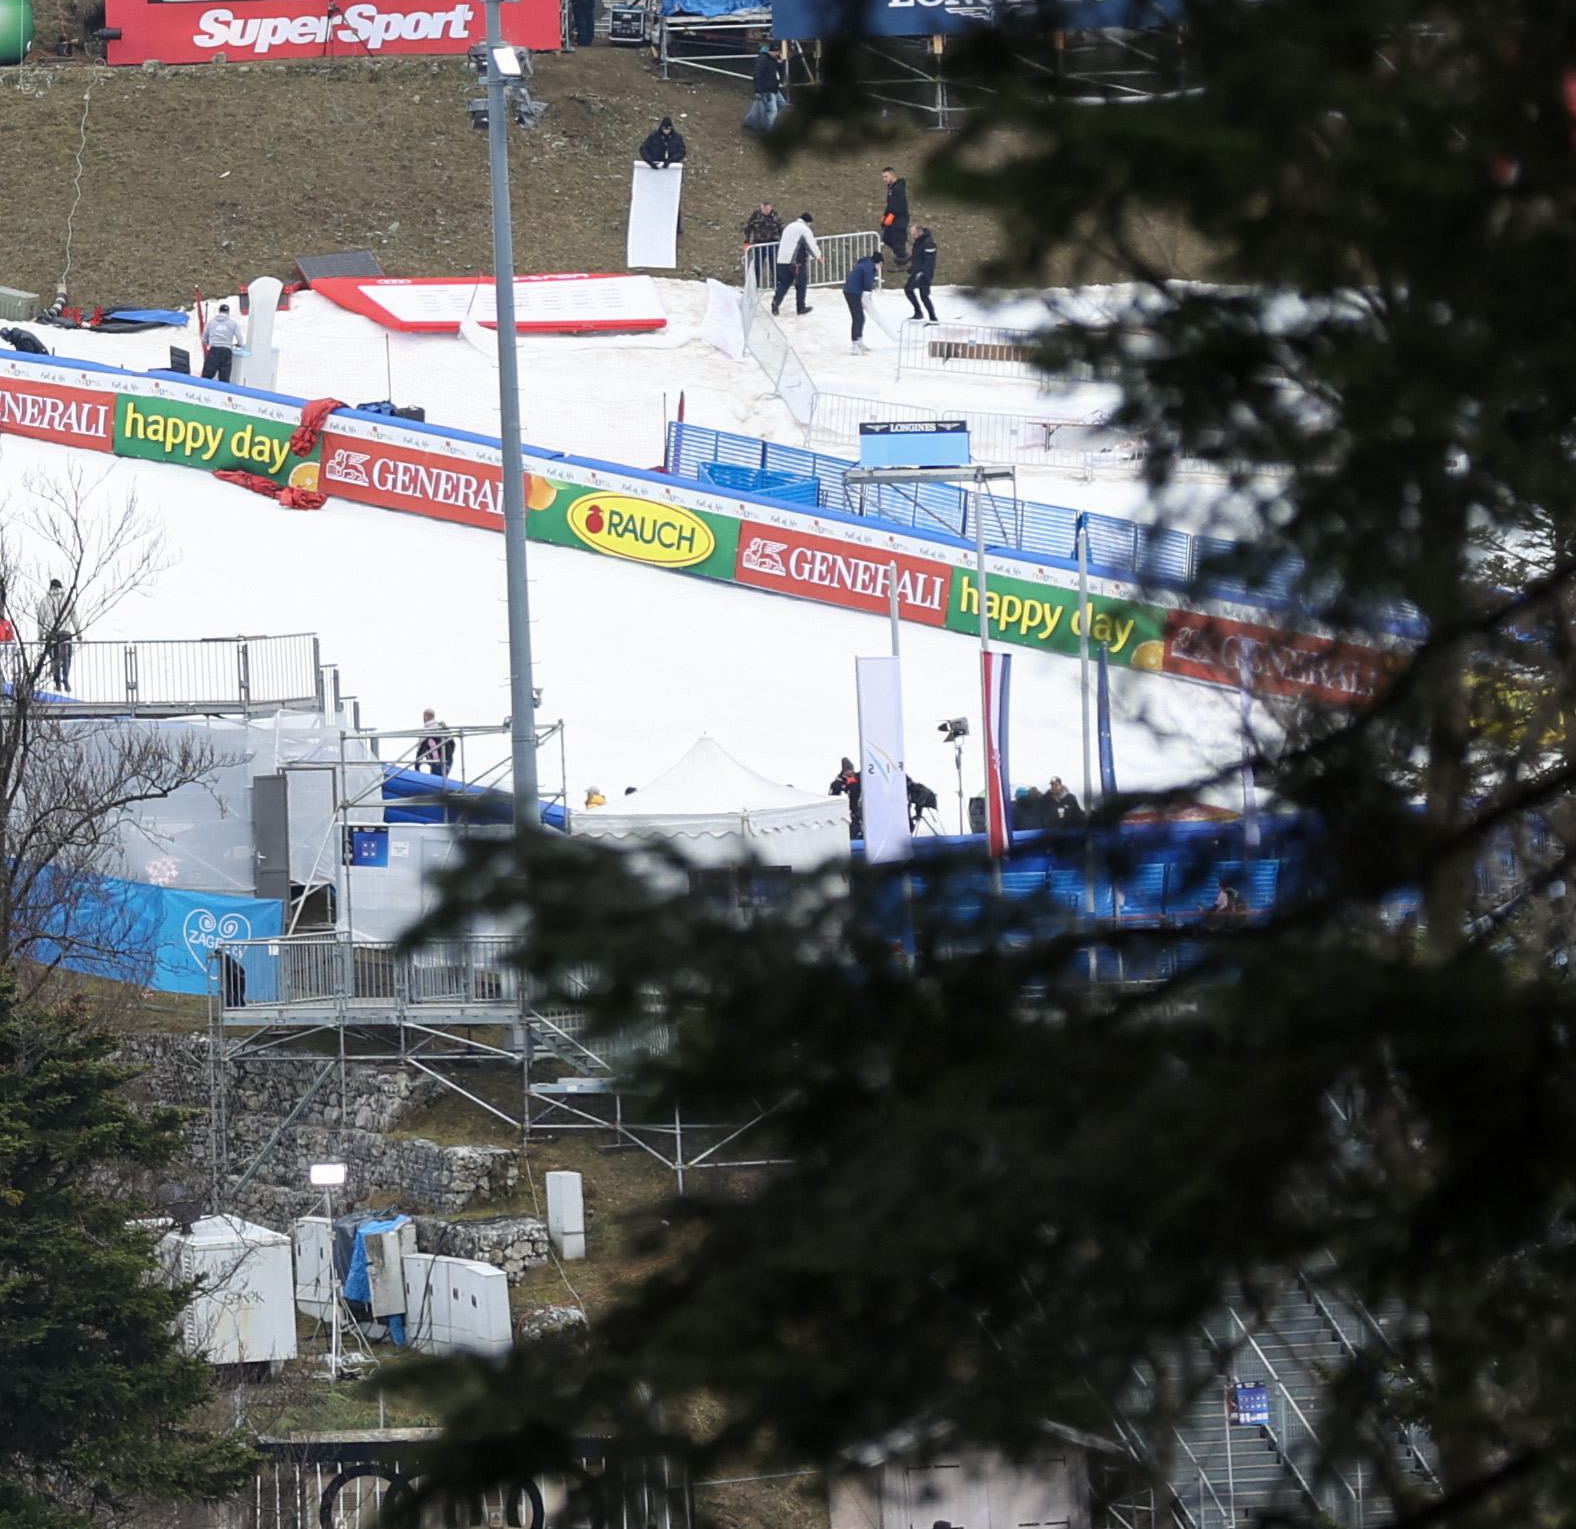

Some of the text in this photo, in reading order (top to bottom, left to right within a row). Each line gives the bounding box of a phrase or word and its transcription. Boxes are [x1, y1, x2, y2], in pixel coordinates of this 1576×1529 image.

[193, 3, 475, 54] SuperSport
[124, 402, 290, 474] happy day
[890, 423, 937, 432] LONGINES
[607, 510, 696, 553] RAUCH
[960, 576, 1064, 640] happy
